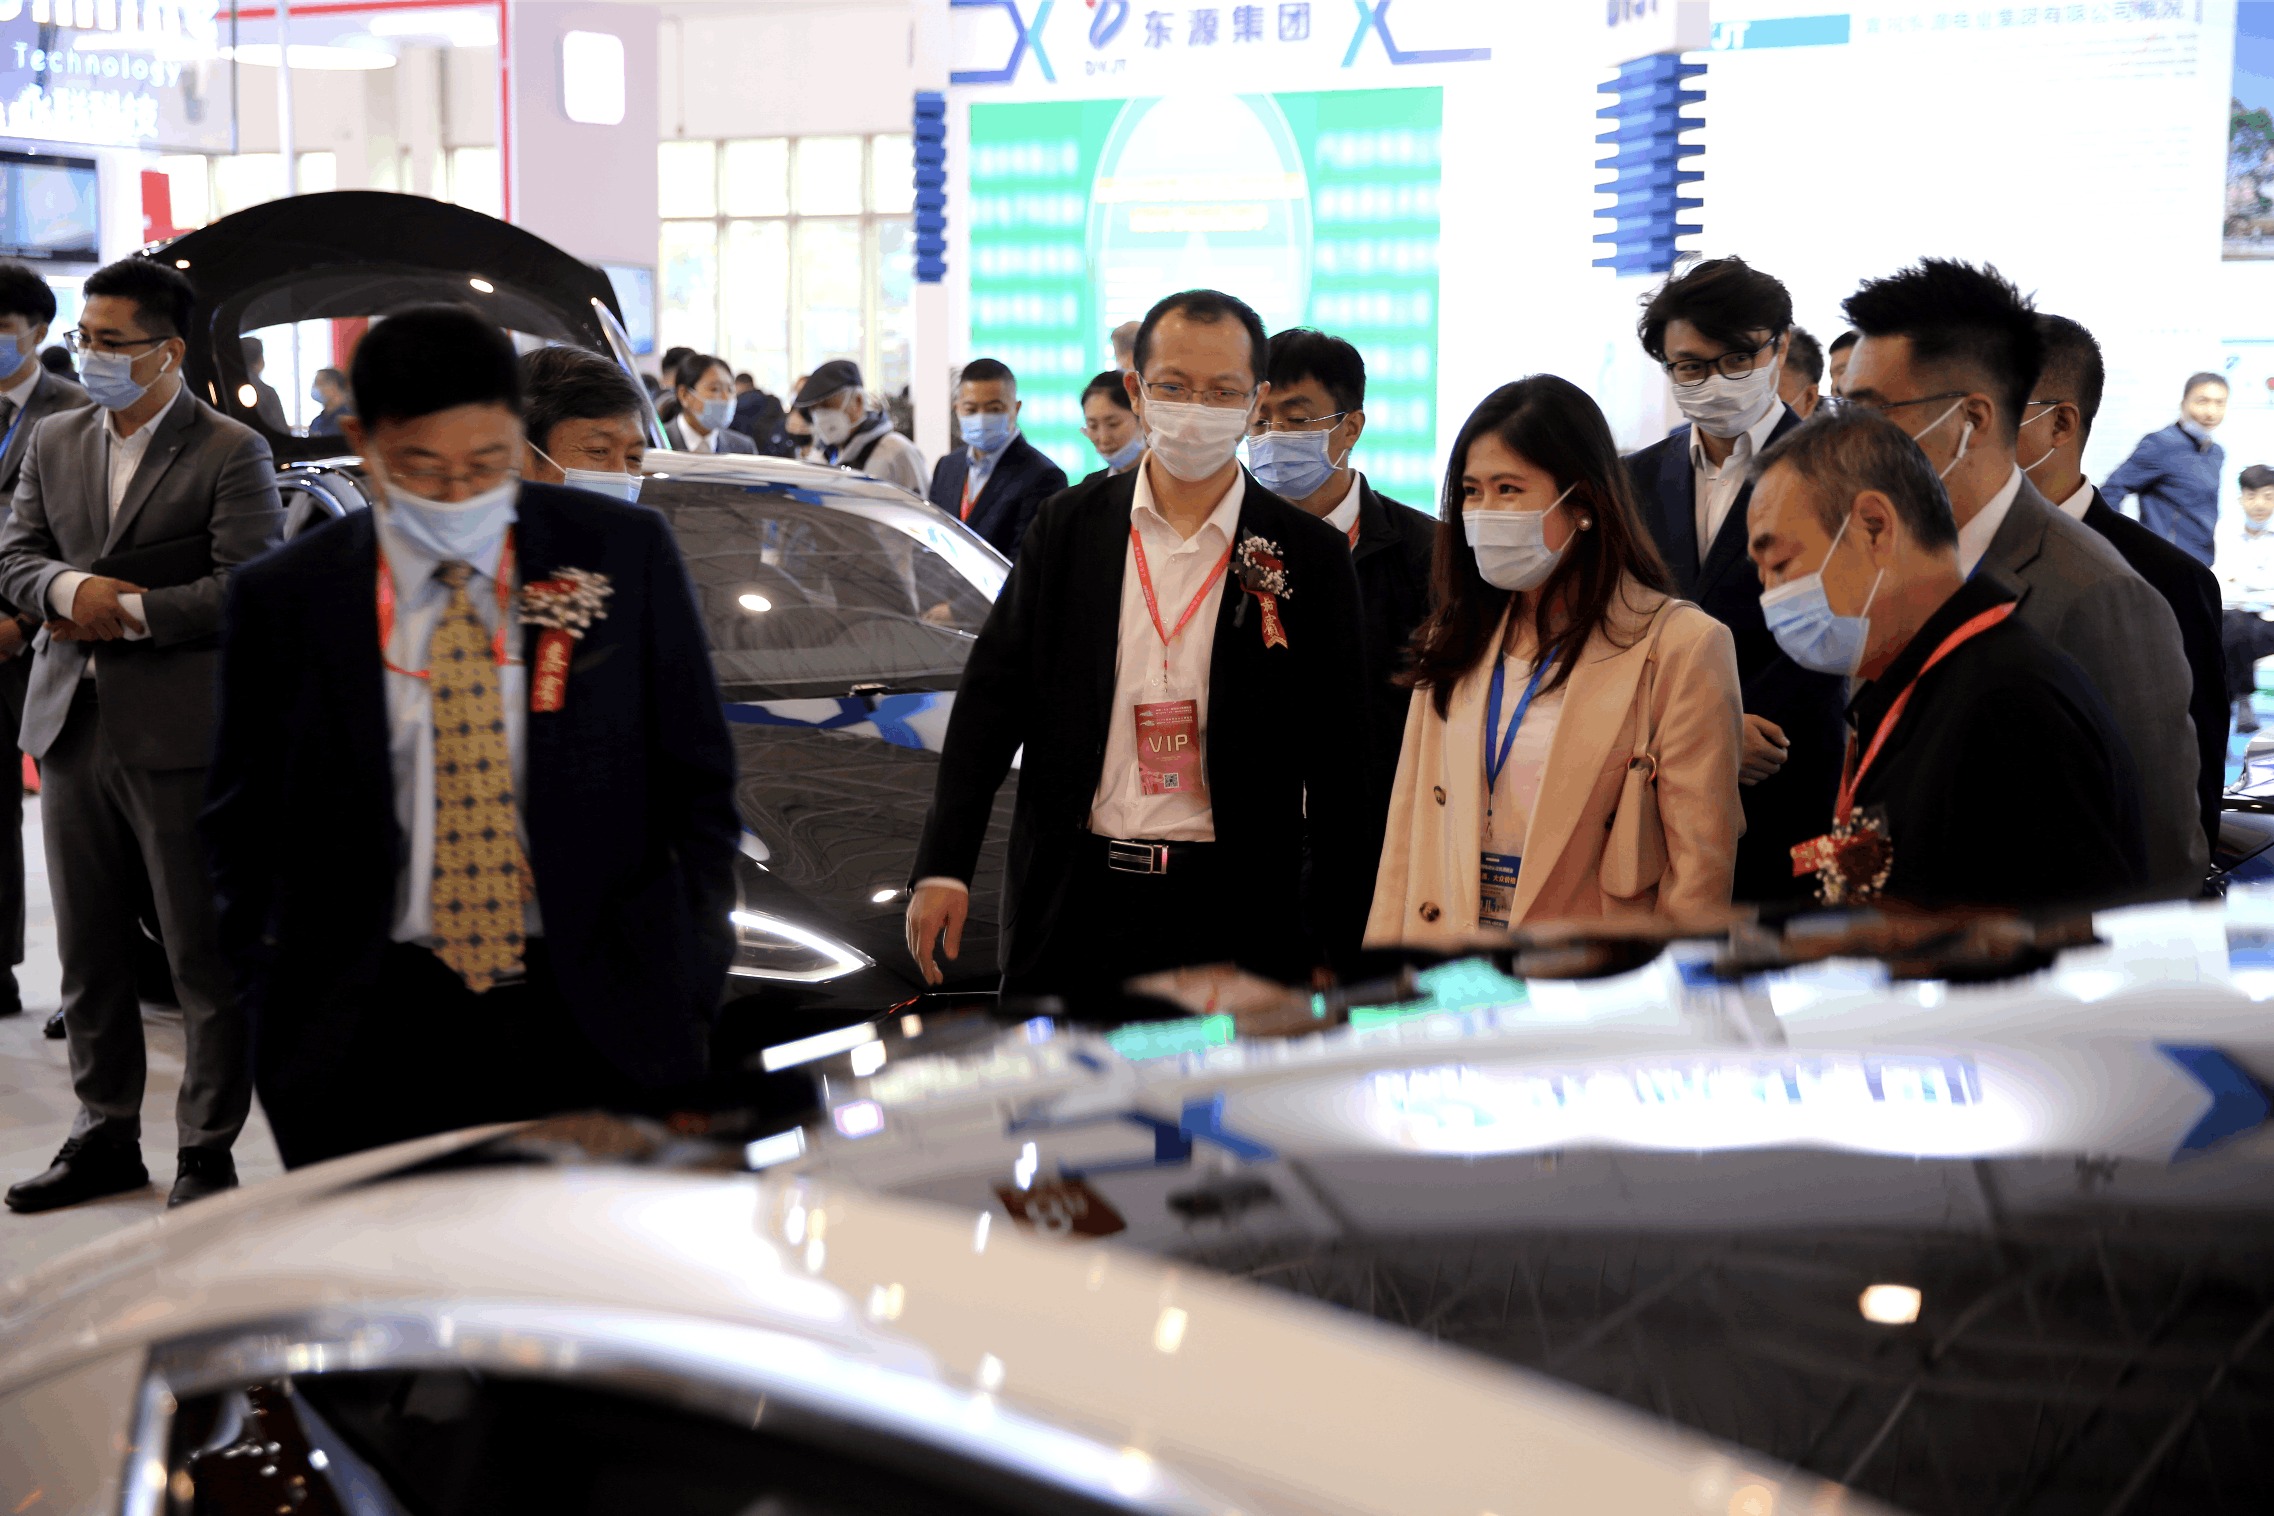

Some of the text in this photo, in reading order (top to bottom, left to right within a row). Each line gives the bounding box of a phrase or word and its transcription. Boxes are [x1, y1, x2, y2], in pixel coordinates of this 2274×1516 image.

[1144, 2, 1311, 49] 东源集团
[14, 41, 182, 88] Technology
[1148, 733, 1189, 754] VIP
